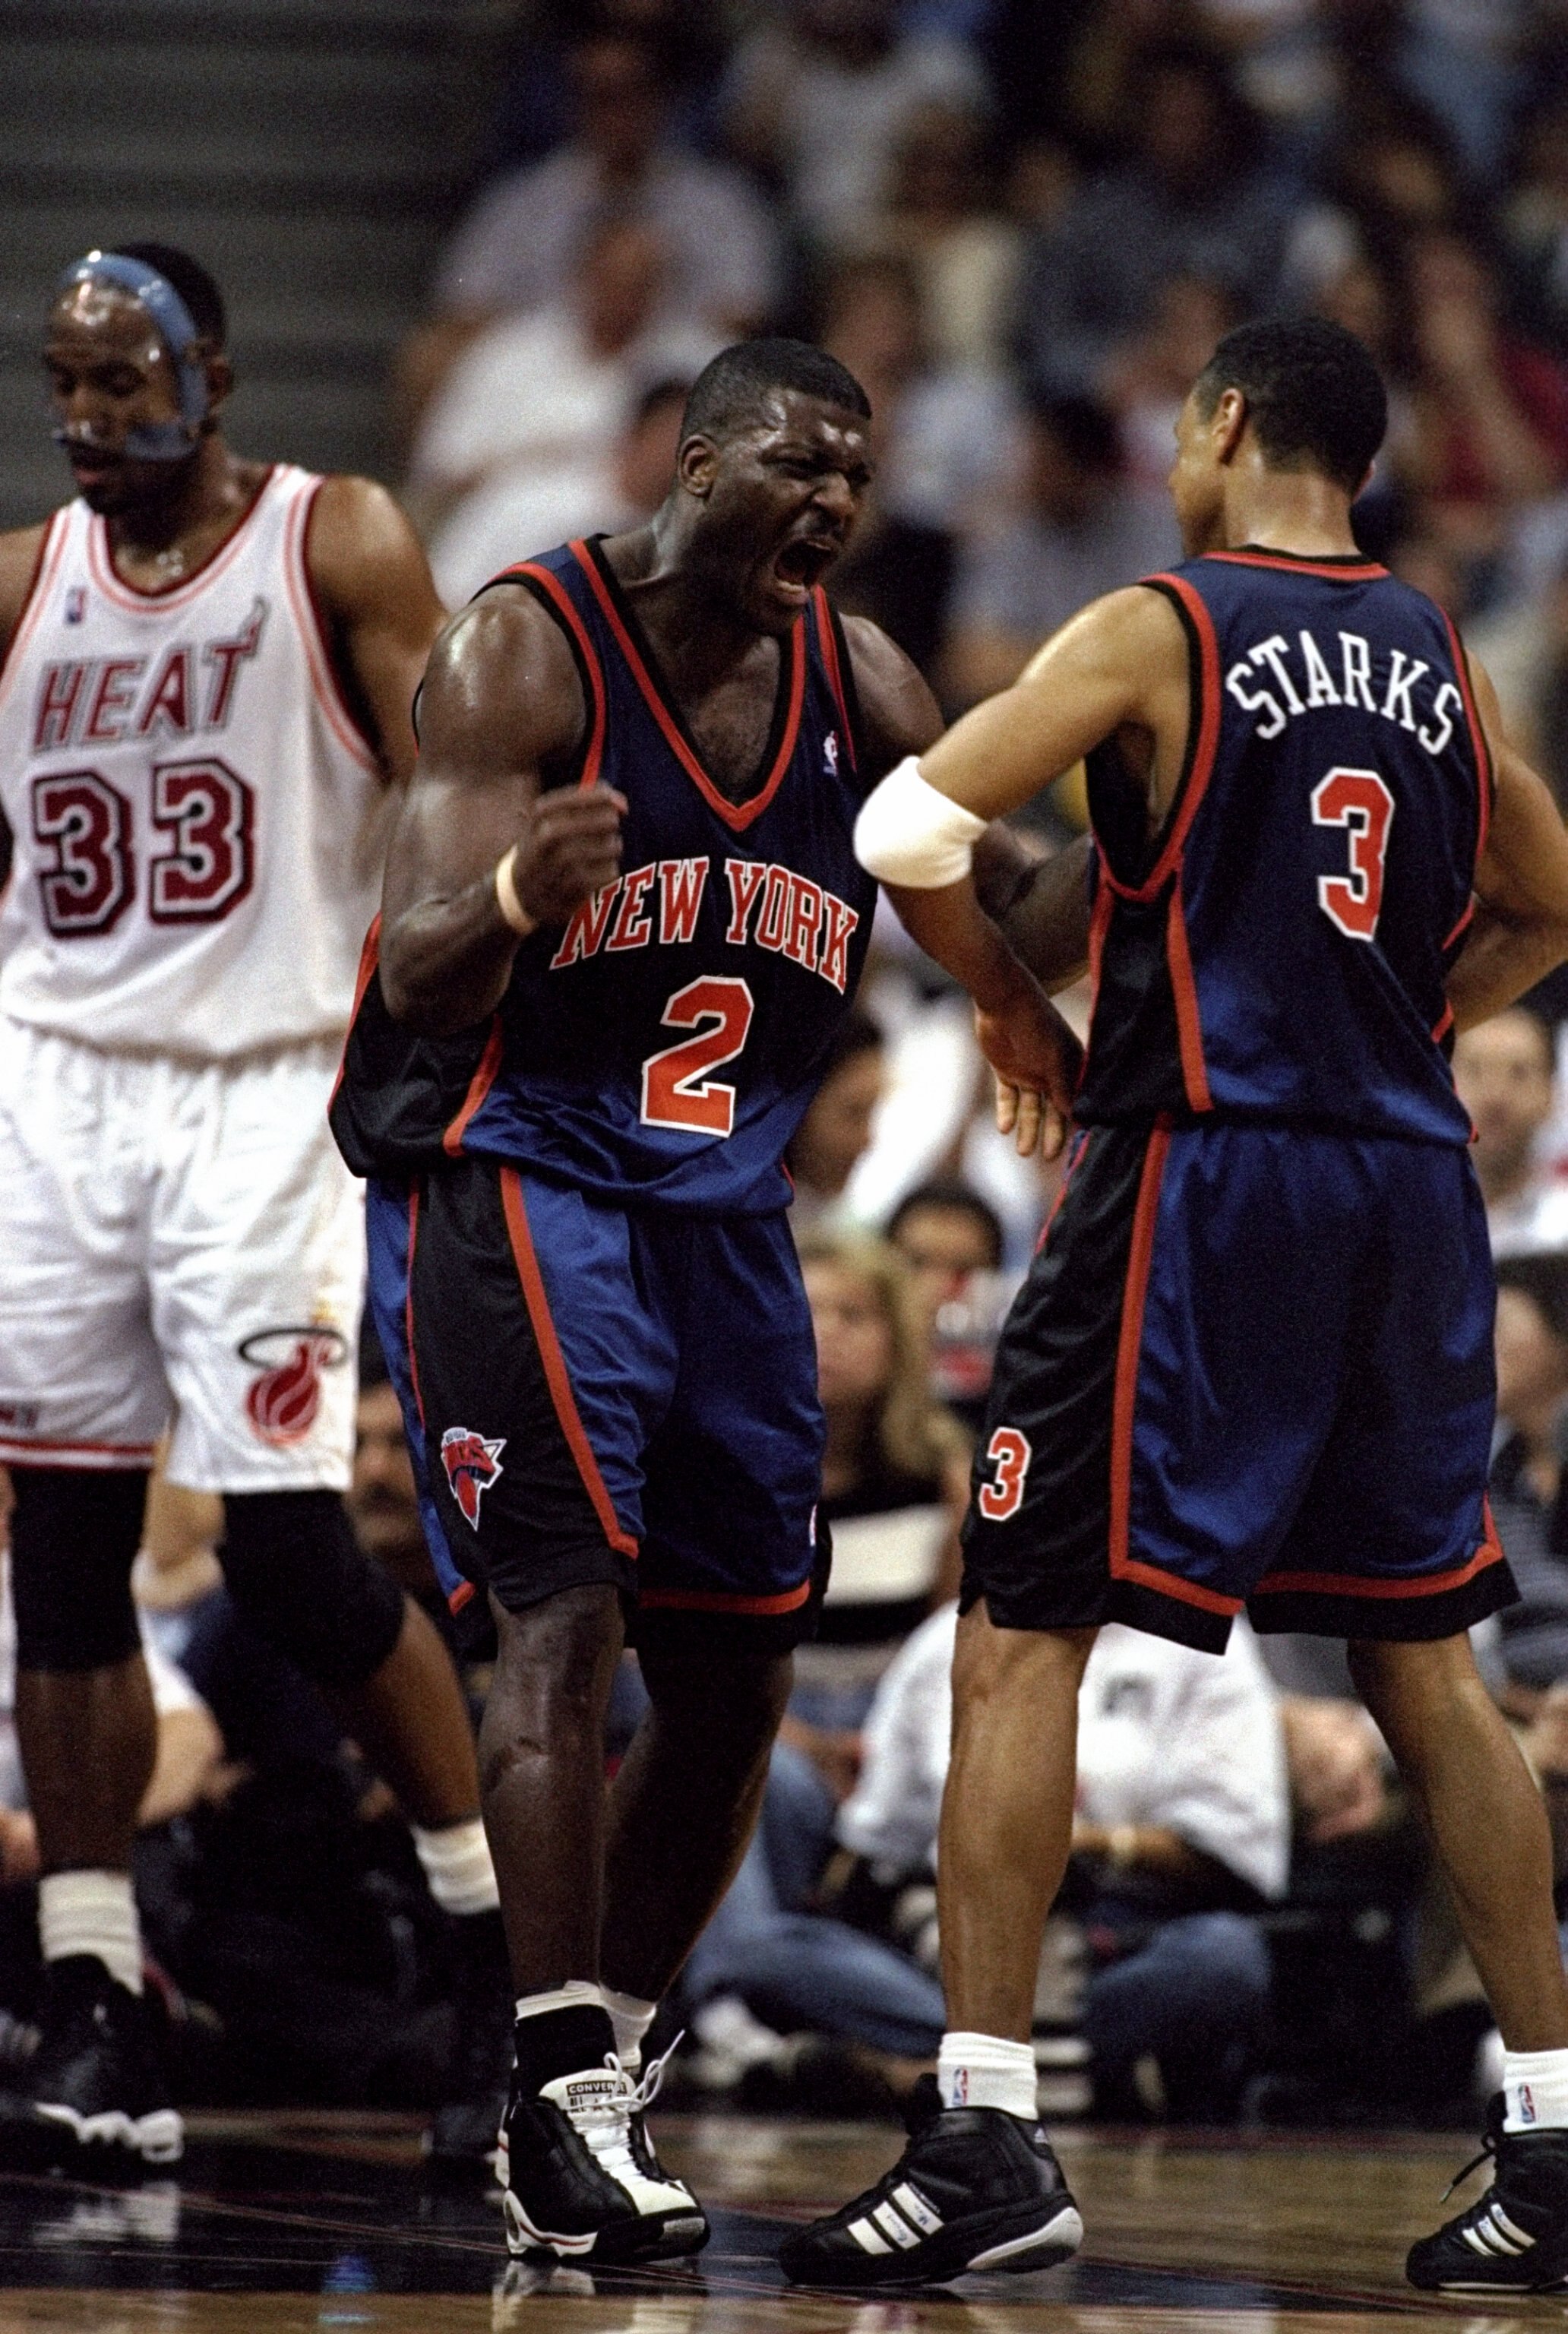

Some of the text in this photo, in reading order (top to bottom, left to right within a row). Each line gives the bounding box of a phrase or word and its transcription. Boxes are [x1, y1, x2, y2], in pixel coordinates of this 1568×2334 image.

[33, 597, 268, 752] HEAT
[1224, 629, 1462, 755] STARKS
[32, 757, 255, 940] 33
[1310, 766, 1396, 941] 3
[550, 855, 859, 995] NEW YORK
[640, 975, 754, 1138] 2
[978, 1426, 1032, 1522] 3
[568, 2082, 625, 2094] CONVERE
